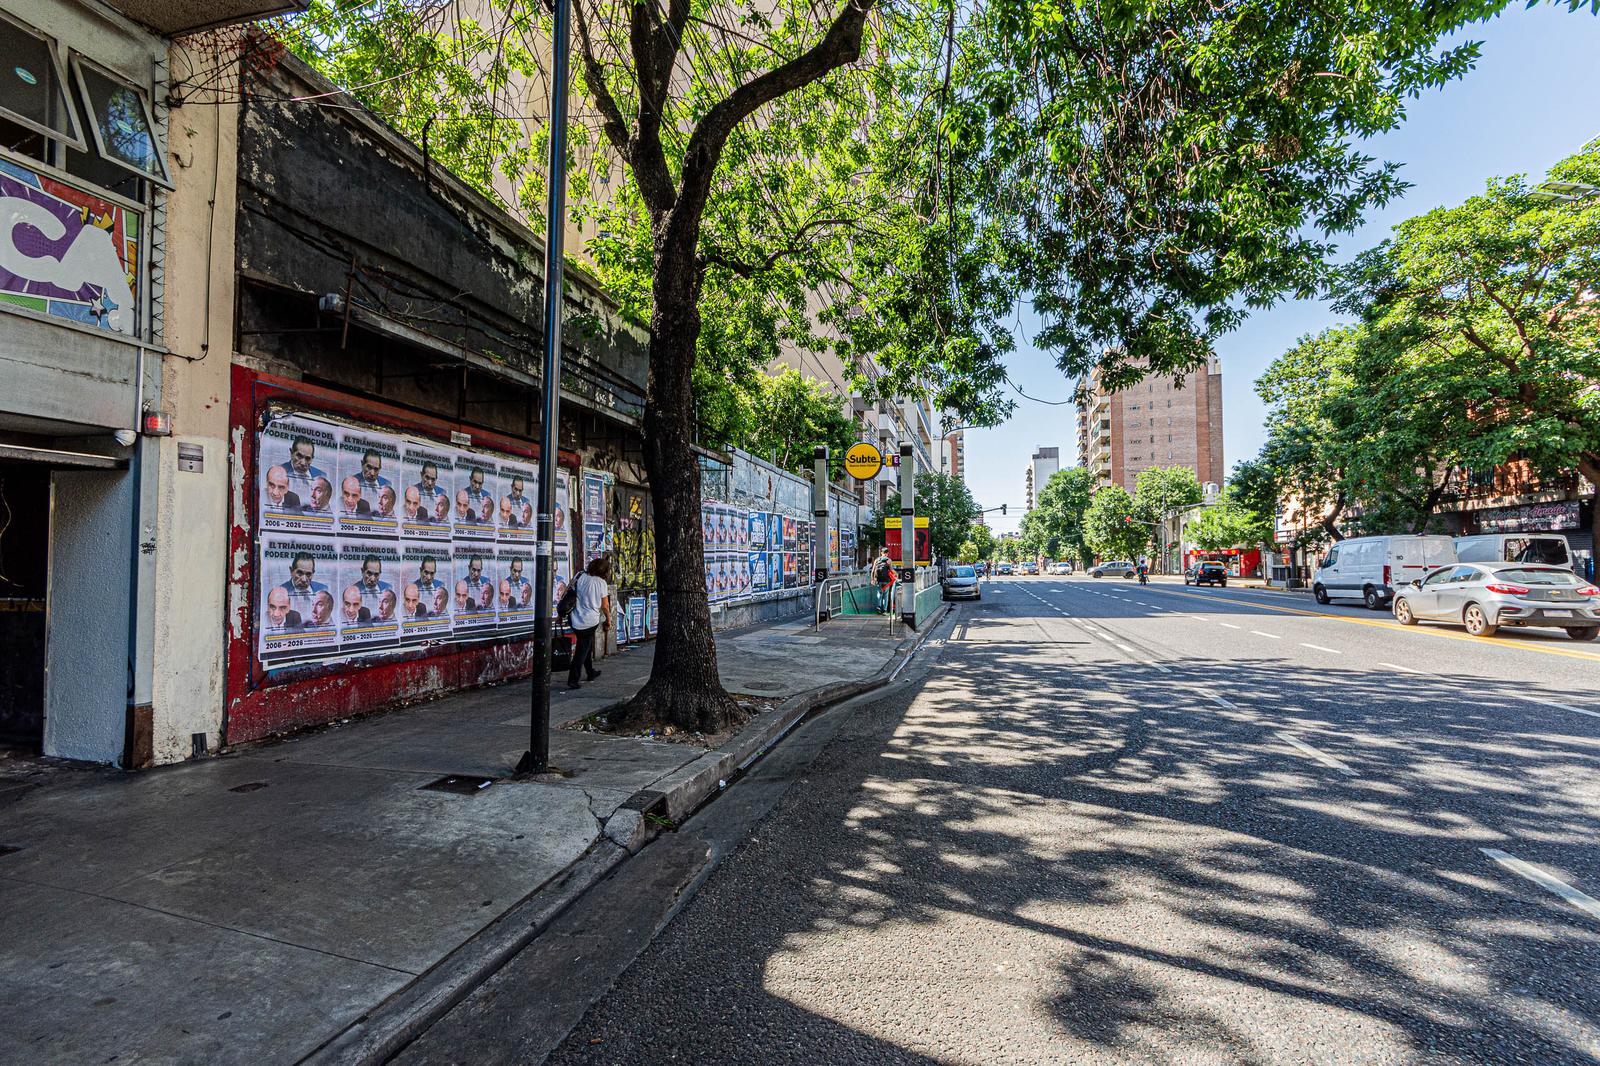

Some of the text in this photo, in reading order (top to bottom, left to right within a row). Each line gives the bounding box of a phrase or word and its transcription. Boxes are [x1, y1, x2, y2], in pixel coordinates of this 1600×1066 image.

[264, 428, 289, 440] PODER
[279, 422, 320, 436] TRIÁNGULO
[322, 432, 334, 440] DEL
[340, 443, 360, 453] PODER
[370, 450, 400, 460] CUMÁN
[849, 454, 878, 463] Subte
[278, 541, 320, 551] TRIÁNGULO
[818, 571, 824, 580] S
[904, 571, 911, 580] S
